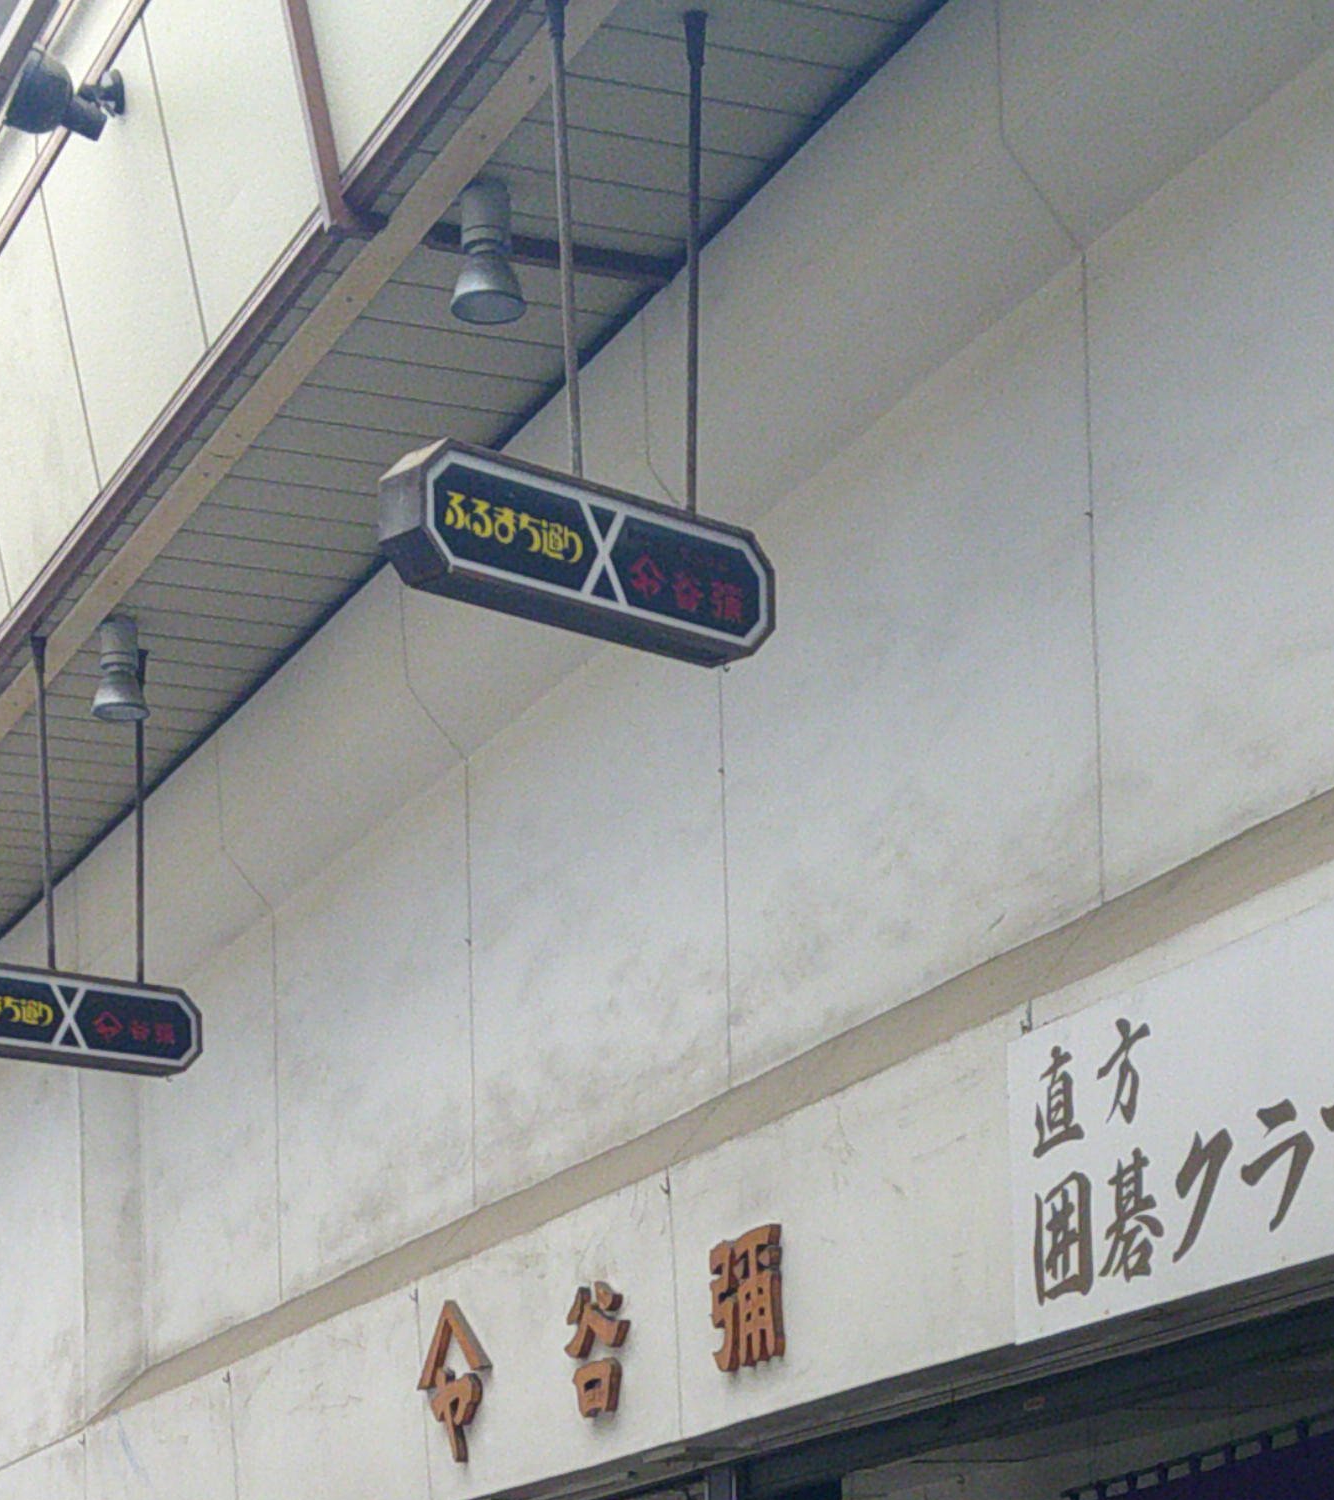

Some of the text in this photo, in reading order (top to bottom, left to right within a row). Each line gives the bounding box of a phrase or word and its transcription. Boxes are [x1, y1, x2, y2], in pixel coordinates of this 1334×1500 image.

[445, 490, 583, 563] ふるまち通り
[1033, 1017, 1154, 1160] 直方
